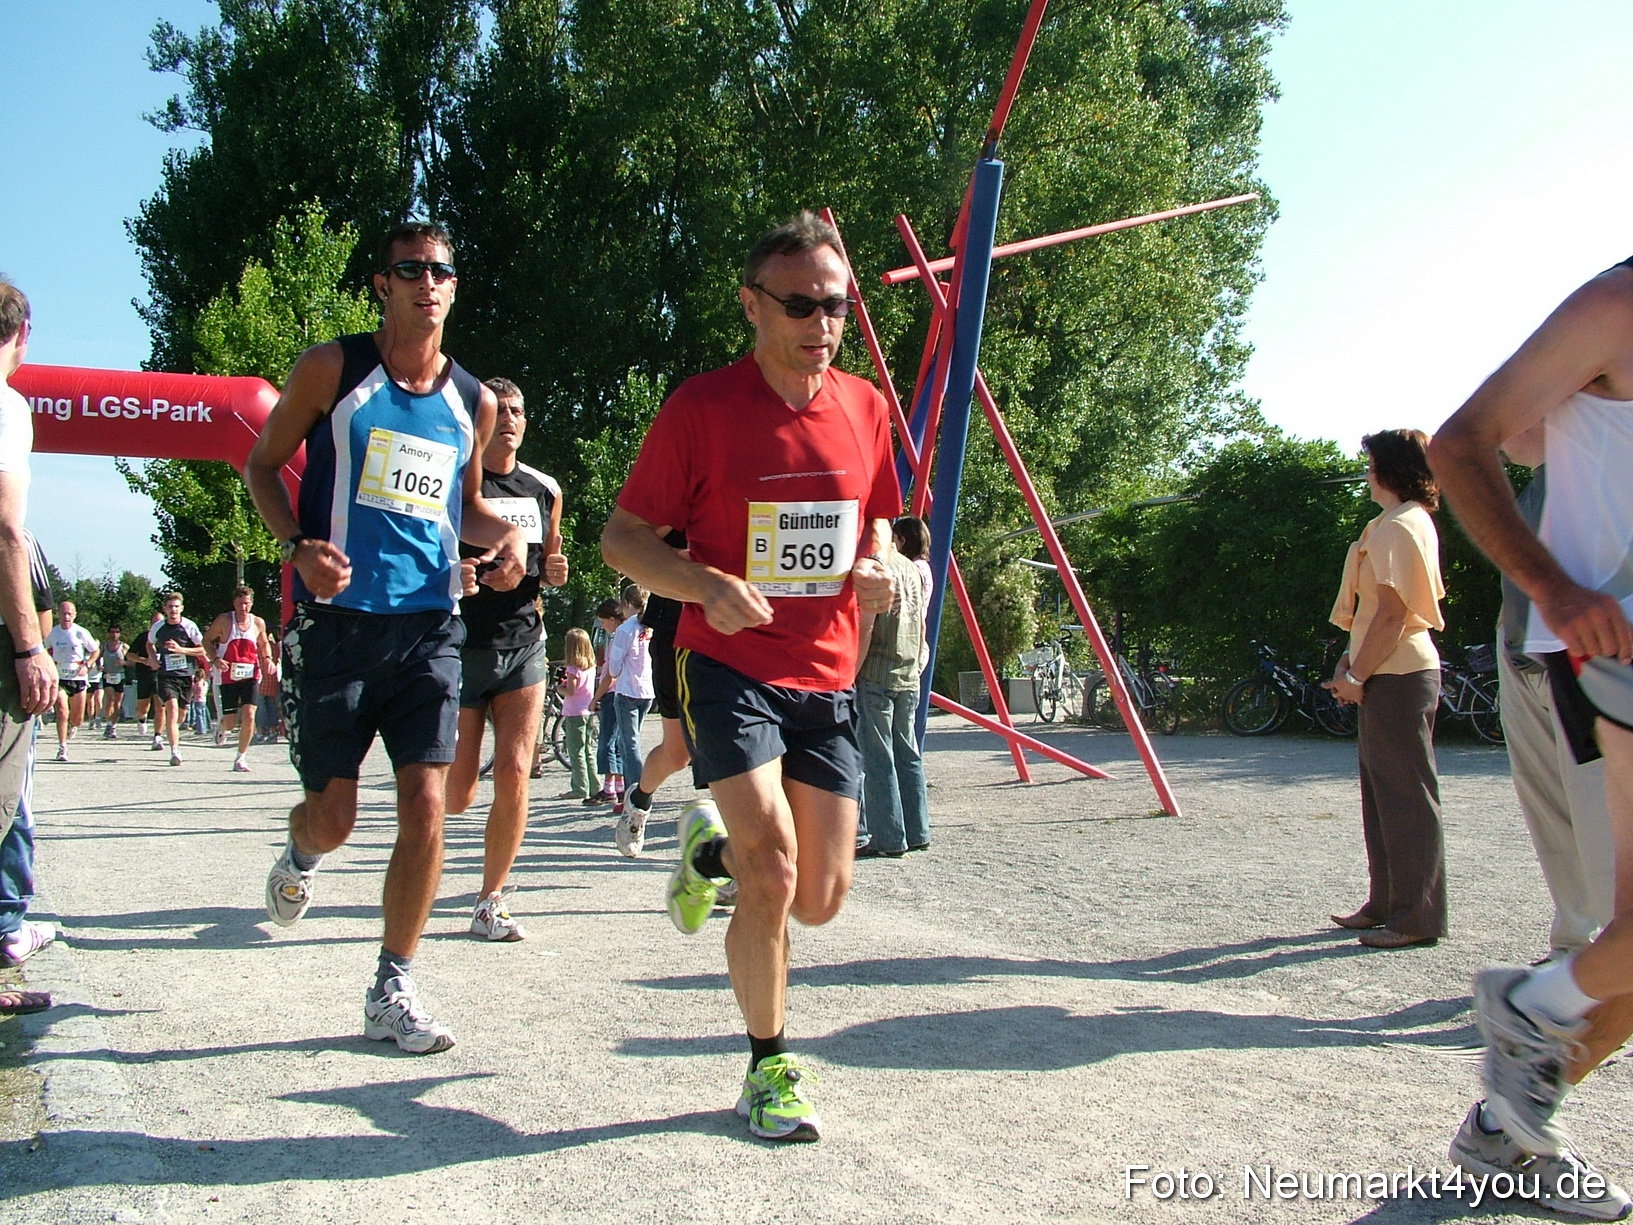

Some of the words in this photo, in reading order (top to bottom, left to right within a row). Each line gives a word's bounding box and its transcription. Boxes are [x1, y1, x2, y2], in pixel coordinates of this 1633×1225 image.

[82, 394, 213, 423] LGS-Park
[398, 443, 433, 462] Amory
[391, 468, 443, 499] 1062
[779, 512, 840, 530] Günther
[755, 538, 768, 553] B
[780, 542, 835, 571] 569
